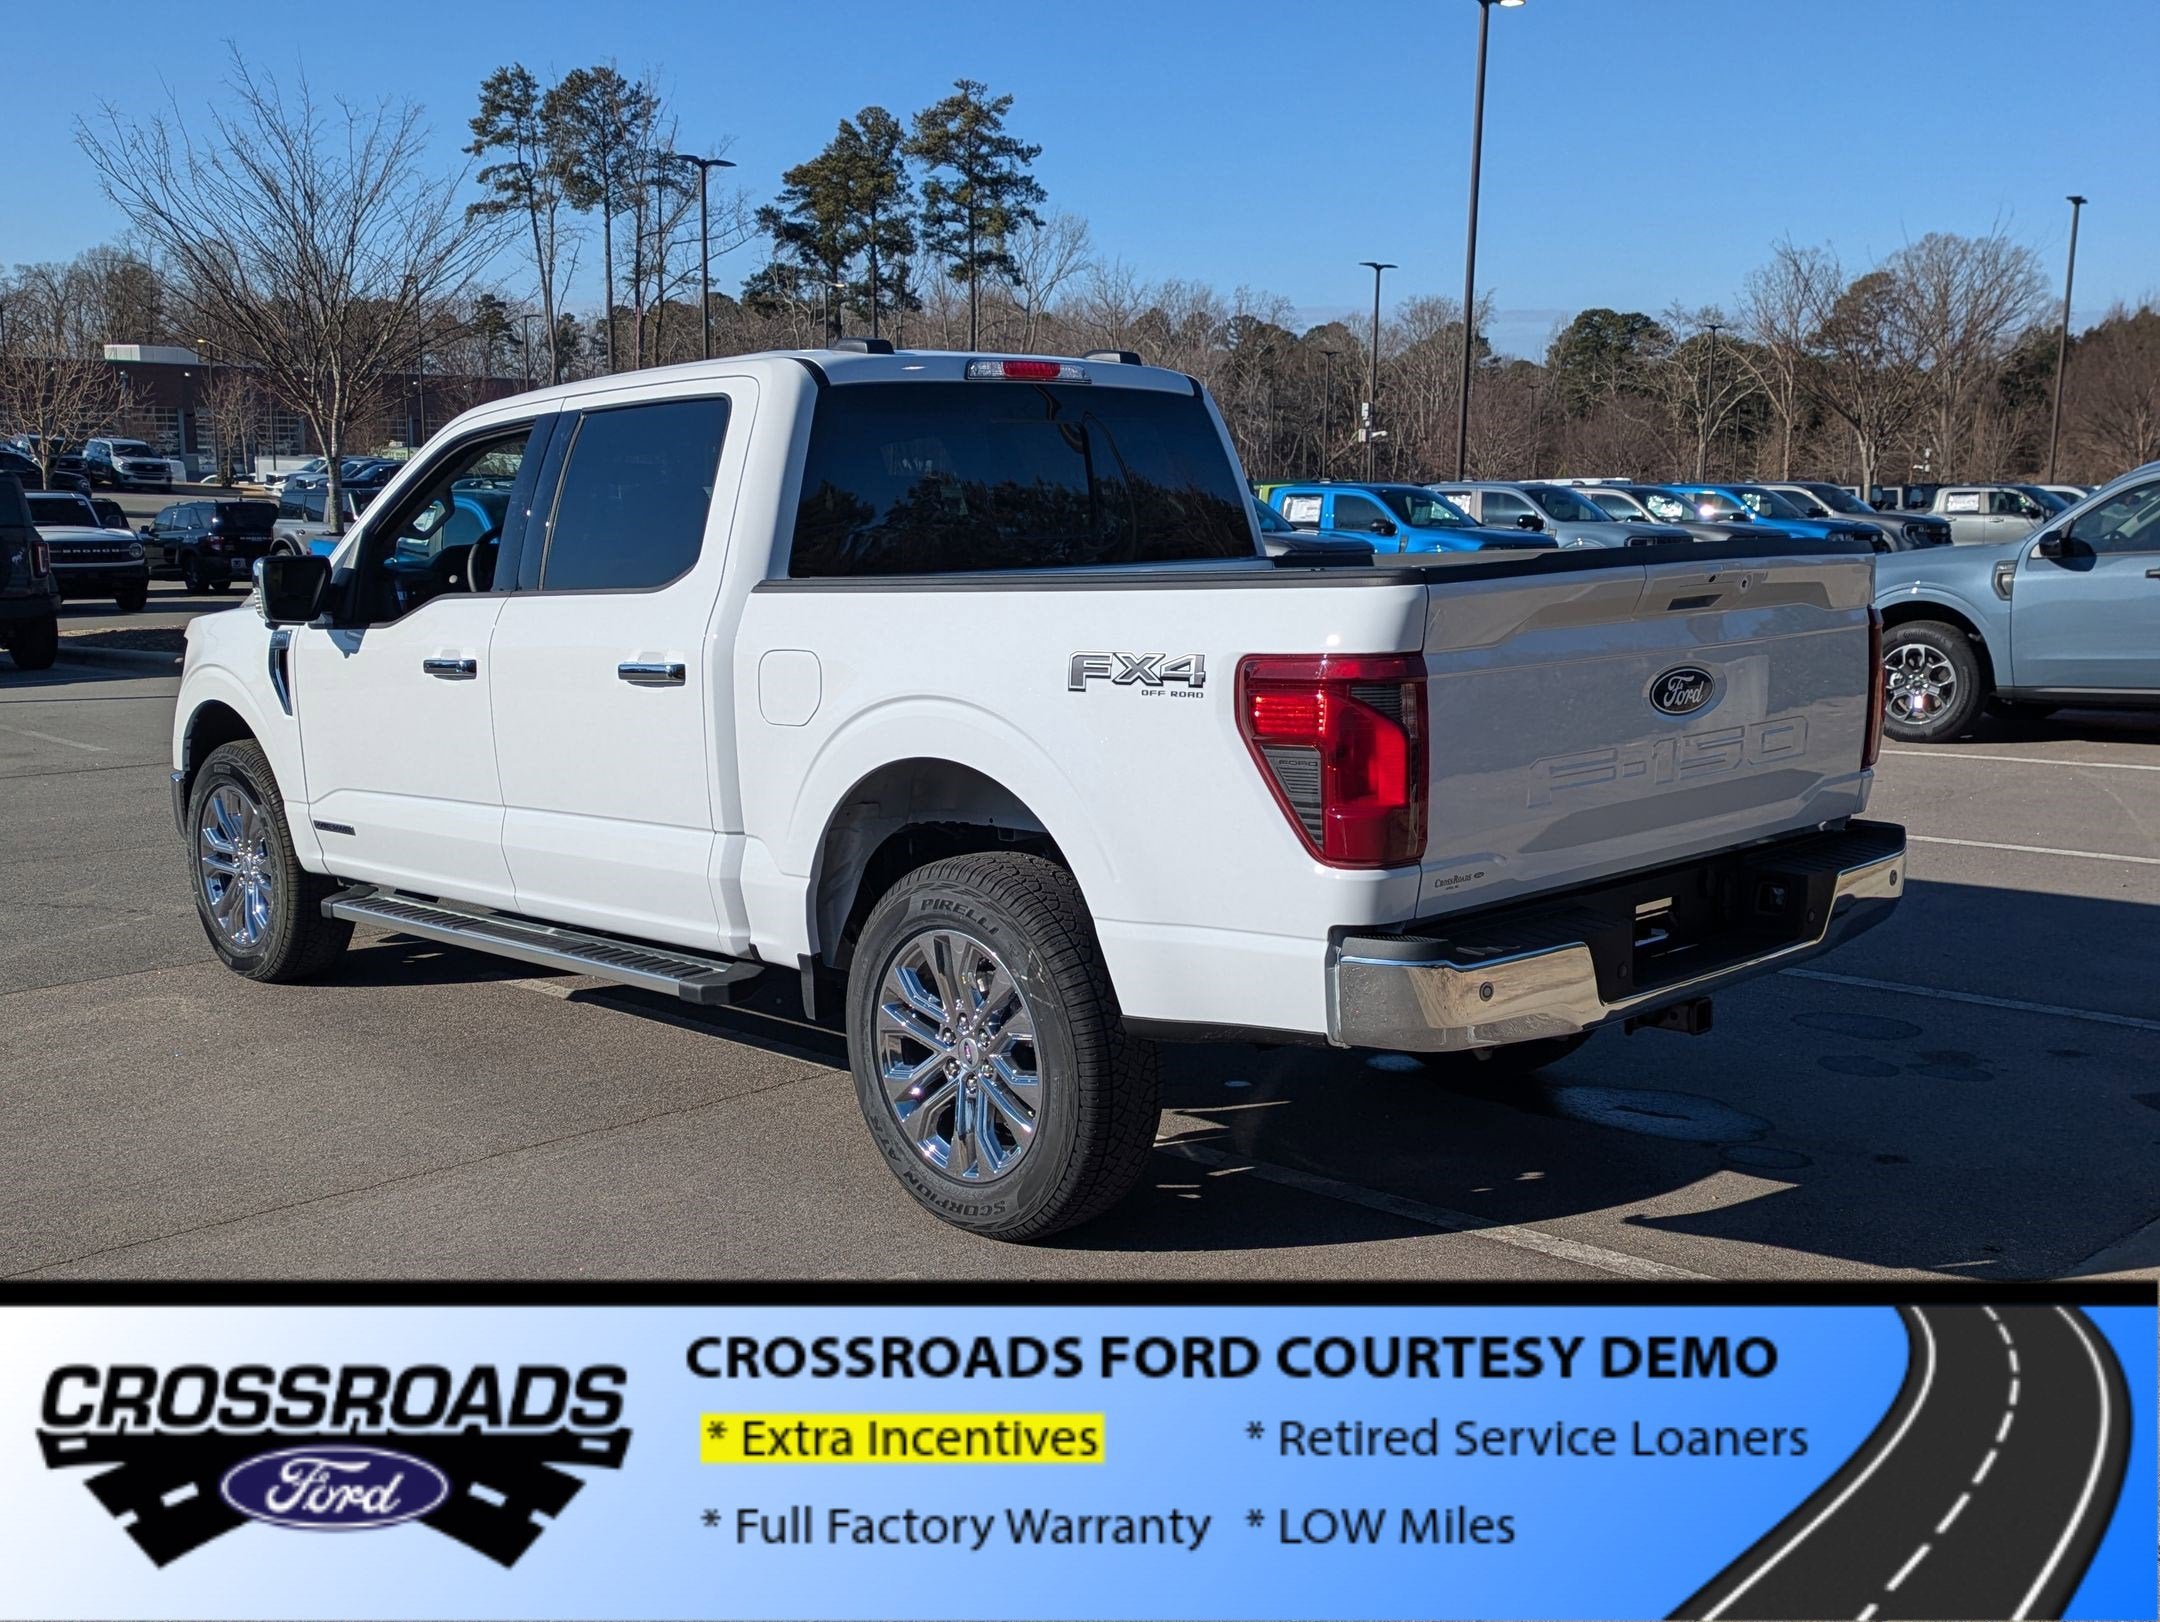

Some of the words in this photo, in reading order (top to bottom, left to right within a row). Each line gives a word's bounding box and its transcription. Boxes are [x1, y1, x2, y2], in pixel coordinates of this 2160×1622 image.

[1068, 651, 1206, 692] FX4
[1141, 689, 1166, 697] OFF
[1170, 690, 1205, 699] ROAD
[1662, 674, 1705, 708] Ford
[920, 898, 1000, 935] PIRELLI
[903, 1170, 1006, 1217] SCORPION
